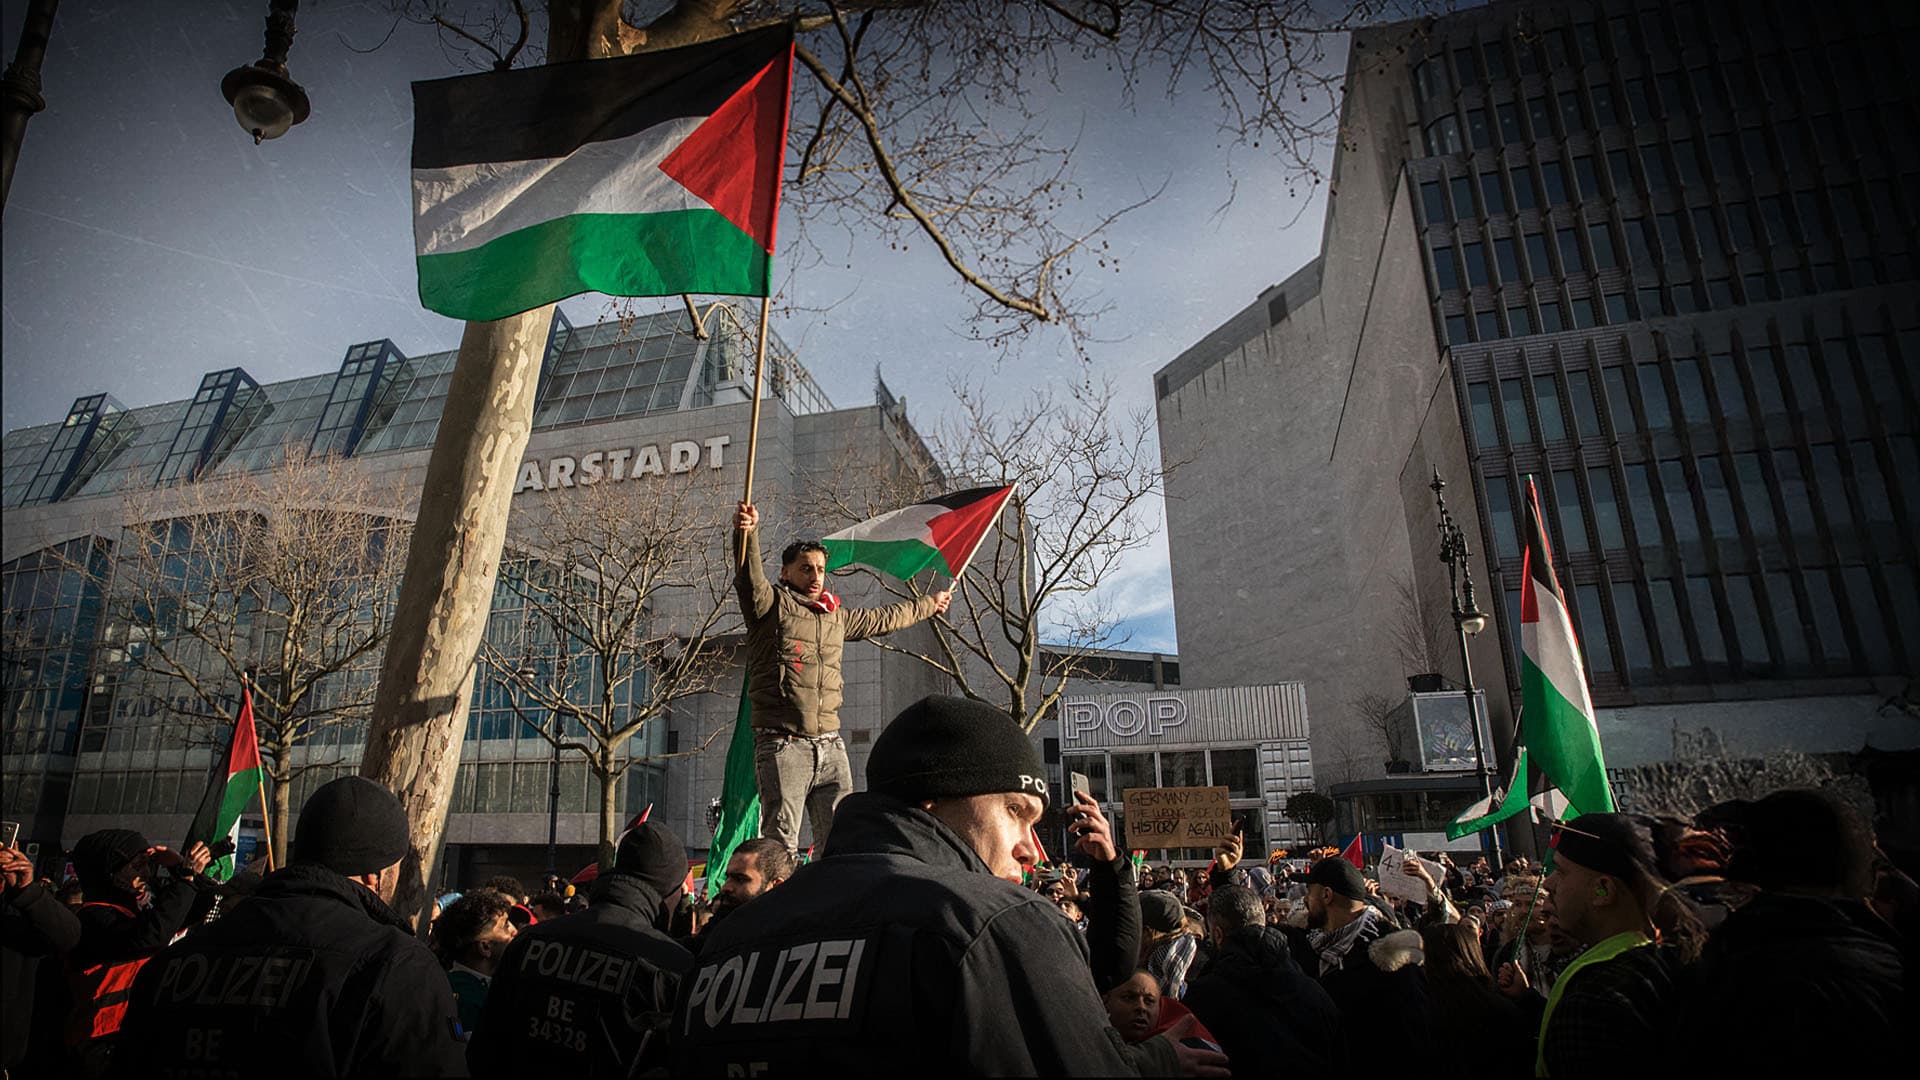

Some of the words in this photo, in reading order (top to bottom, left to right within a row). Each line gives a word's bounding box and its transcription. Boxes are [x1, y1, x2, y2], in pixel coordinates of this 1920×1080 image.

[514, 435, 730, 493] ARSTADT
[1065, 696, 1187, 739] POP
[1018, 775, 1050, 801] PO
[1129, 791, 1190, 806] GERMANY
[1194, 791, 1204, 803] IS
[1211, 791, 1225, 804] ON
[1131, 808, 1149, 818] THE
[1153, 807, 1185, 817] WRONG
[1190, 807, 1208, 818] SIDE
[1132, 819, 1180, 834] HISTORY
[152, 953, 303, 1008] POLIZEI
[520, 939, 632, 995] POLIZEI
[684, 939, 866, 1037] POLIZEI
[547, 995, 576, 1022] BE
[184, 1028, 224, 1061] BE
[528, 1016, 587, 1053] 34328
